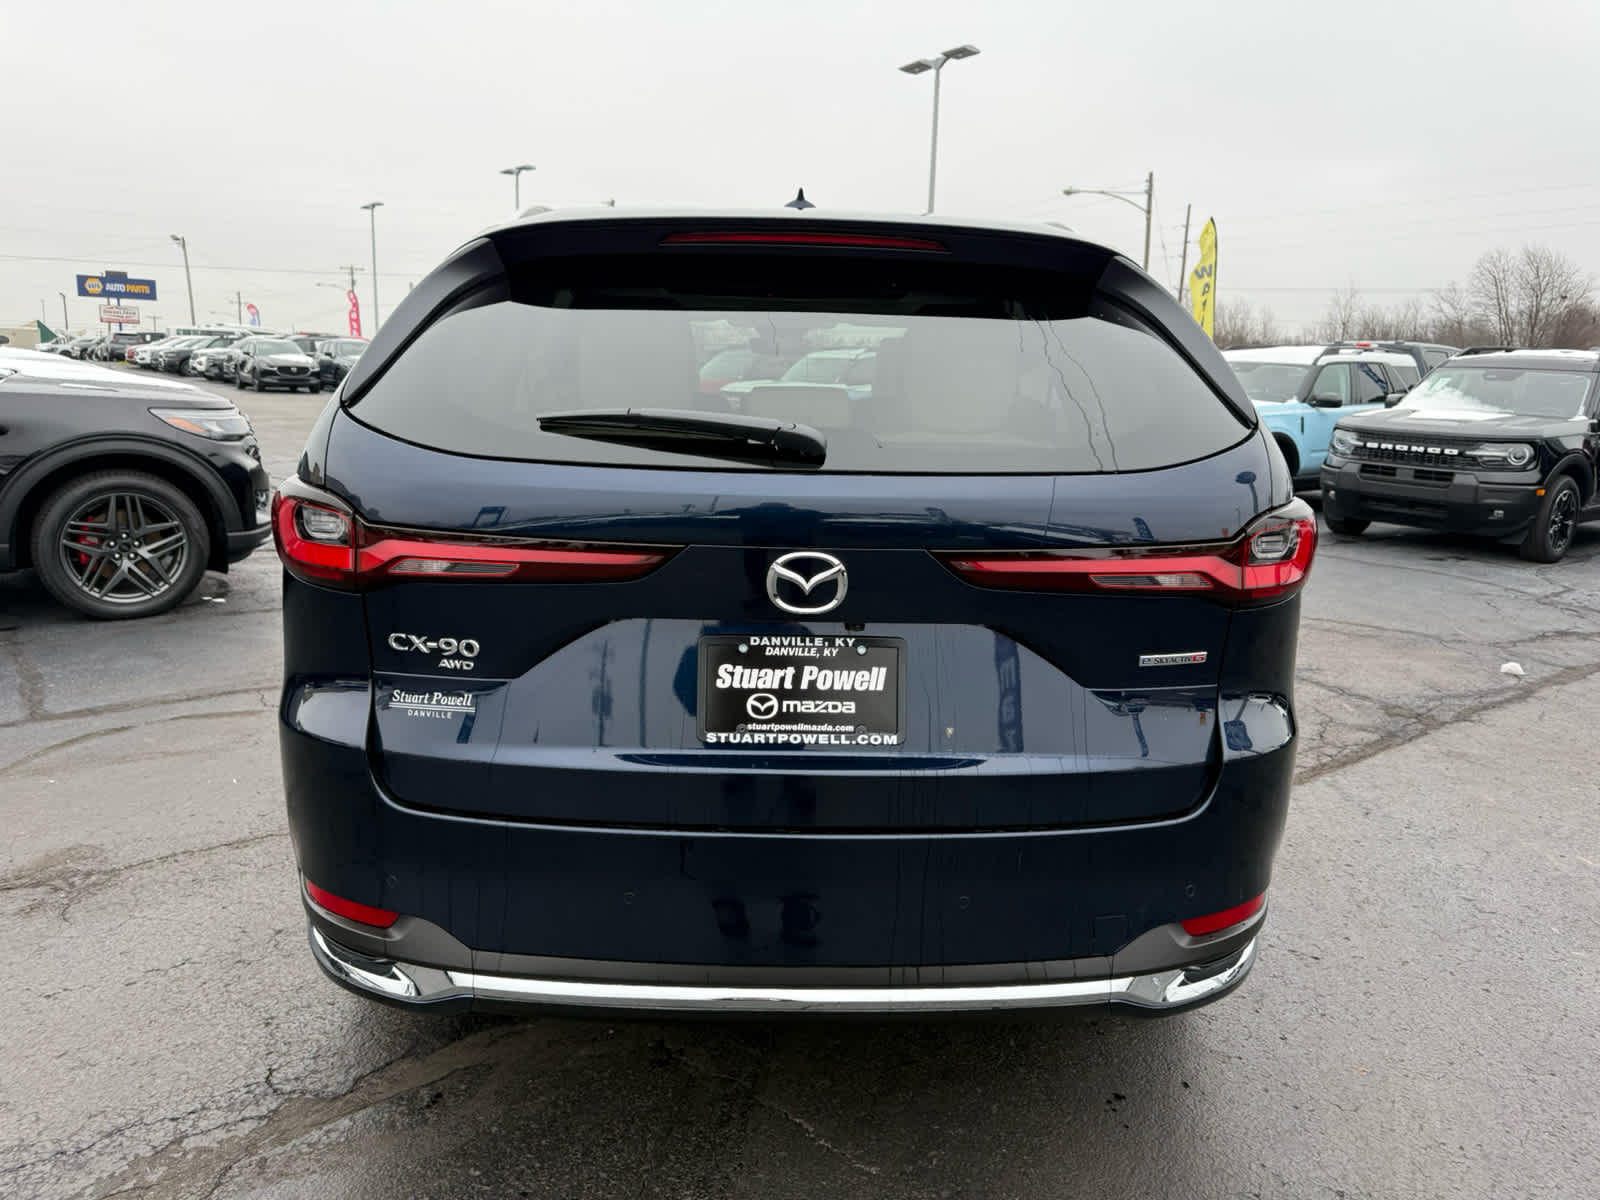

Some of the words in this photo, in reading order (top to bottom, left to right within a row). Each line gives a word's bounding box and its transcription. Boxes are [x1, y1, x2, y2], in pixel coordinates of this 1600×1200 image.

[105, 282, 126, 292] AUTO
[126, 284, 150, 294] PARTS
[1366, 442, 1459, 455] BRONCO
[388, 632, 480, 658] CX-90
[750, 636, 828, 647] DANVILLE,
[835, 638, 856, 647] KY
[765, 646, 820, 658] DANVILLE,
[823, 648, 840, 657] KY
[438, 659, 474, 670] AWD
[716, 664, 795, 689] Stuart
[800, 665, 887, 691] Powell
[392, 689, 430, 704] Stuart
[430, 691, 473, 706] Powell
[782, 700, 856, 713] mazda
[407, 709, 453, 719] DANVILLE
[747, 723, 855, 732] stuartpowellmazda.com
[706, 733, 898, 745] STUARTPOWELL.COM
